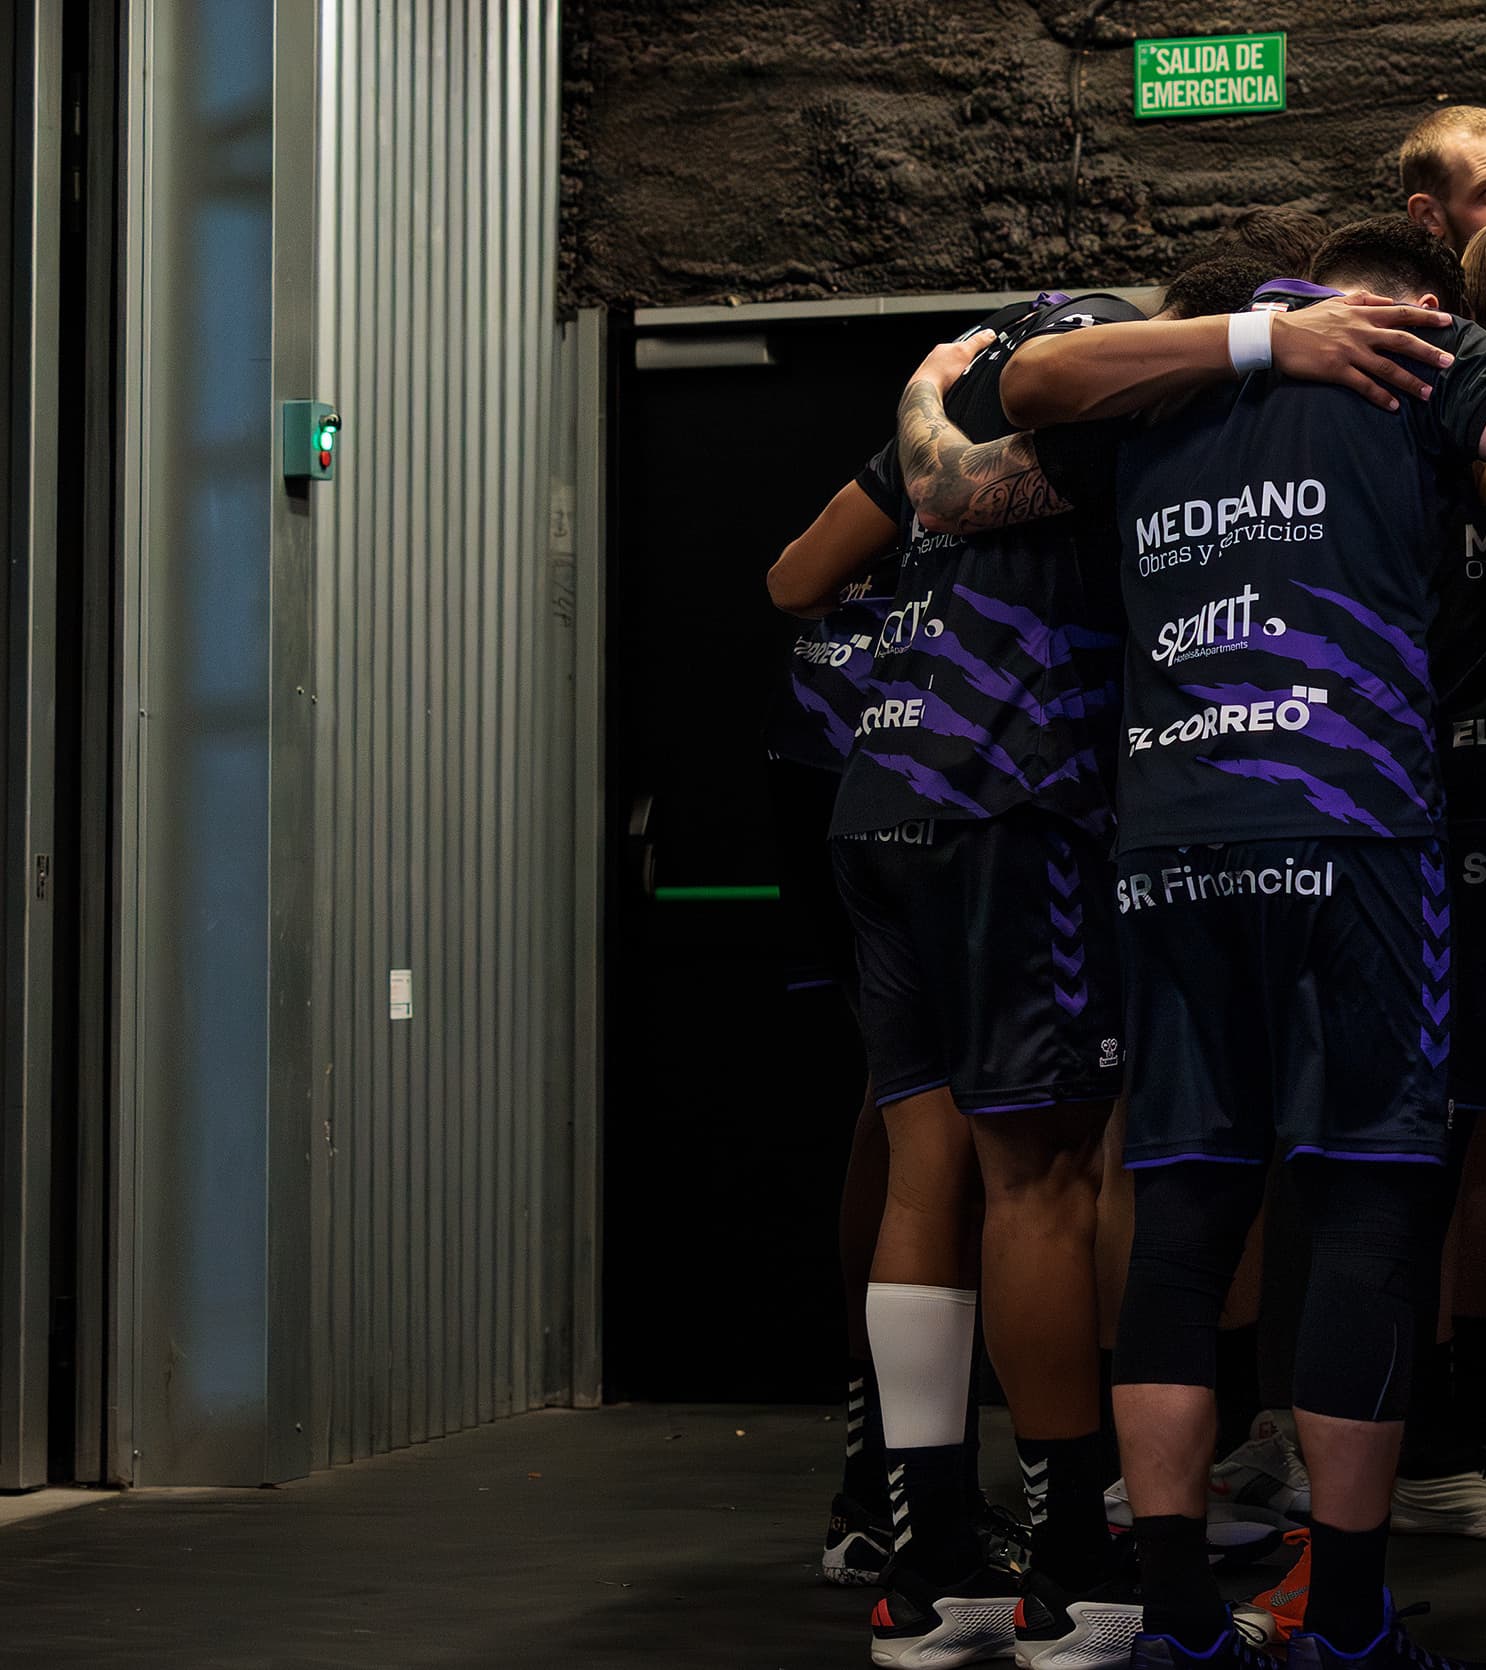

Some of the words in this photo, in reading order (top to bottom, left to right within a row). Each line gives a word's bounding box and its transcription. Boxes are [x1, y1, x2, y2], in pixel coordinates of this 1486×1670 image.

[1155, 45, 1230, 75] SALIDA
[1235, 43, 1264, 71] DE
[1142, 75, 1279, 109] EMERGENCIA
[1138, 546, 1191, 577] Obras
[1197, 543, 1214, 566] y
[1218, 520, 1324, 558] ervicios
[1158, 699, 1311, 746] CORREO
[1117, 873, 1157, 914] SR
[1161, 857, 1334, 904] Financial
